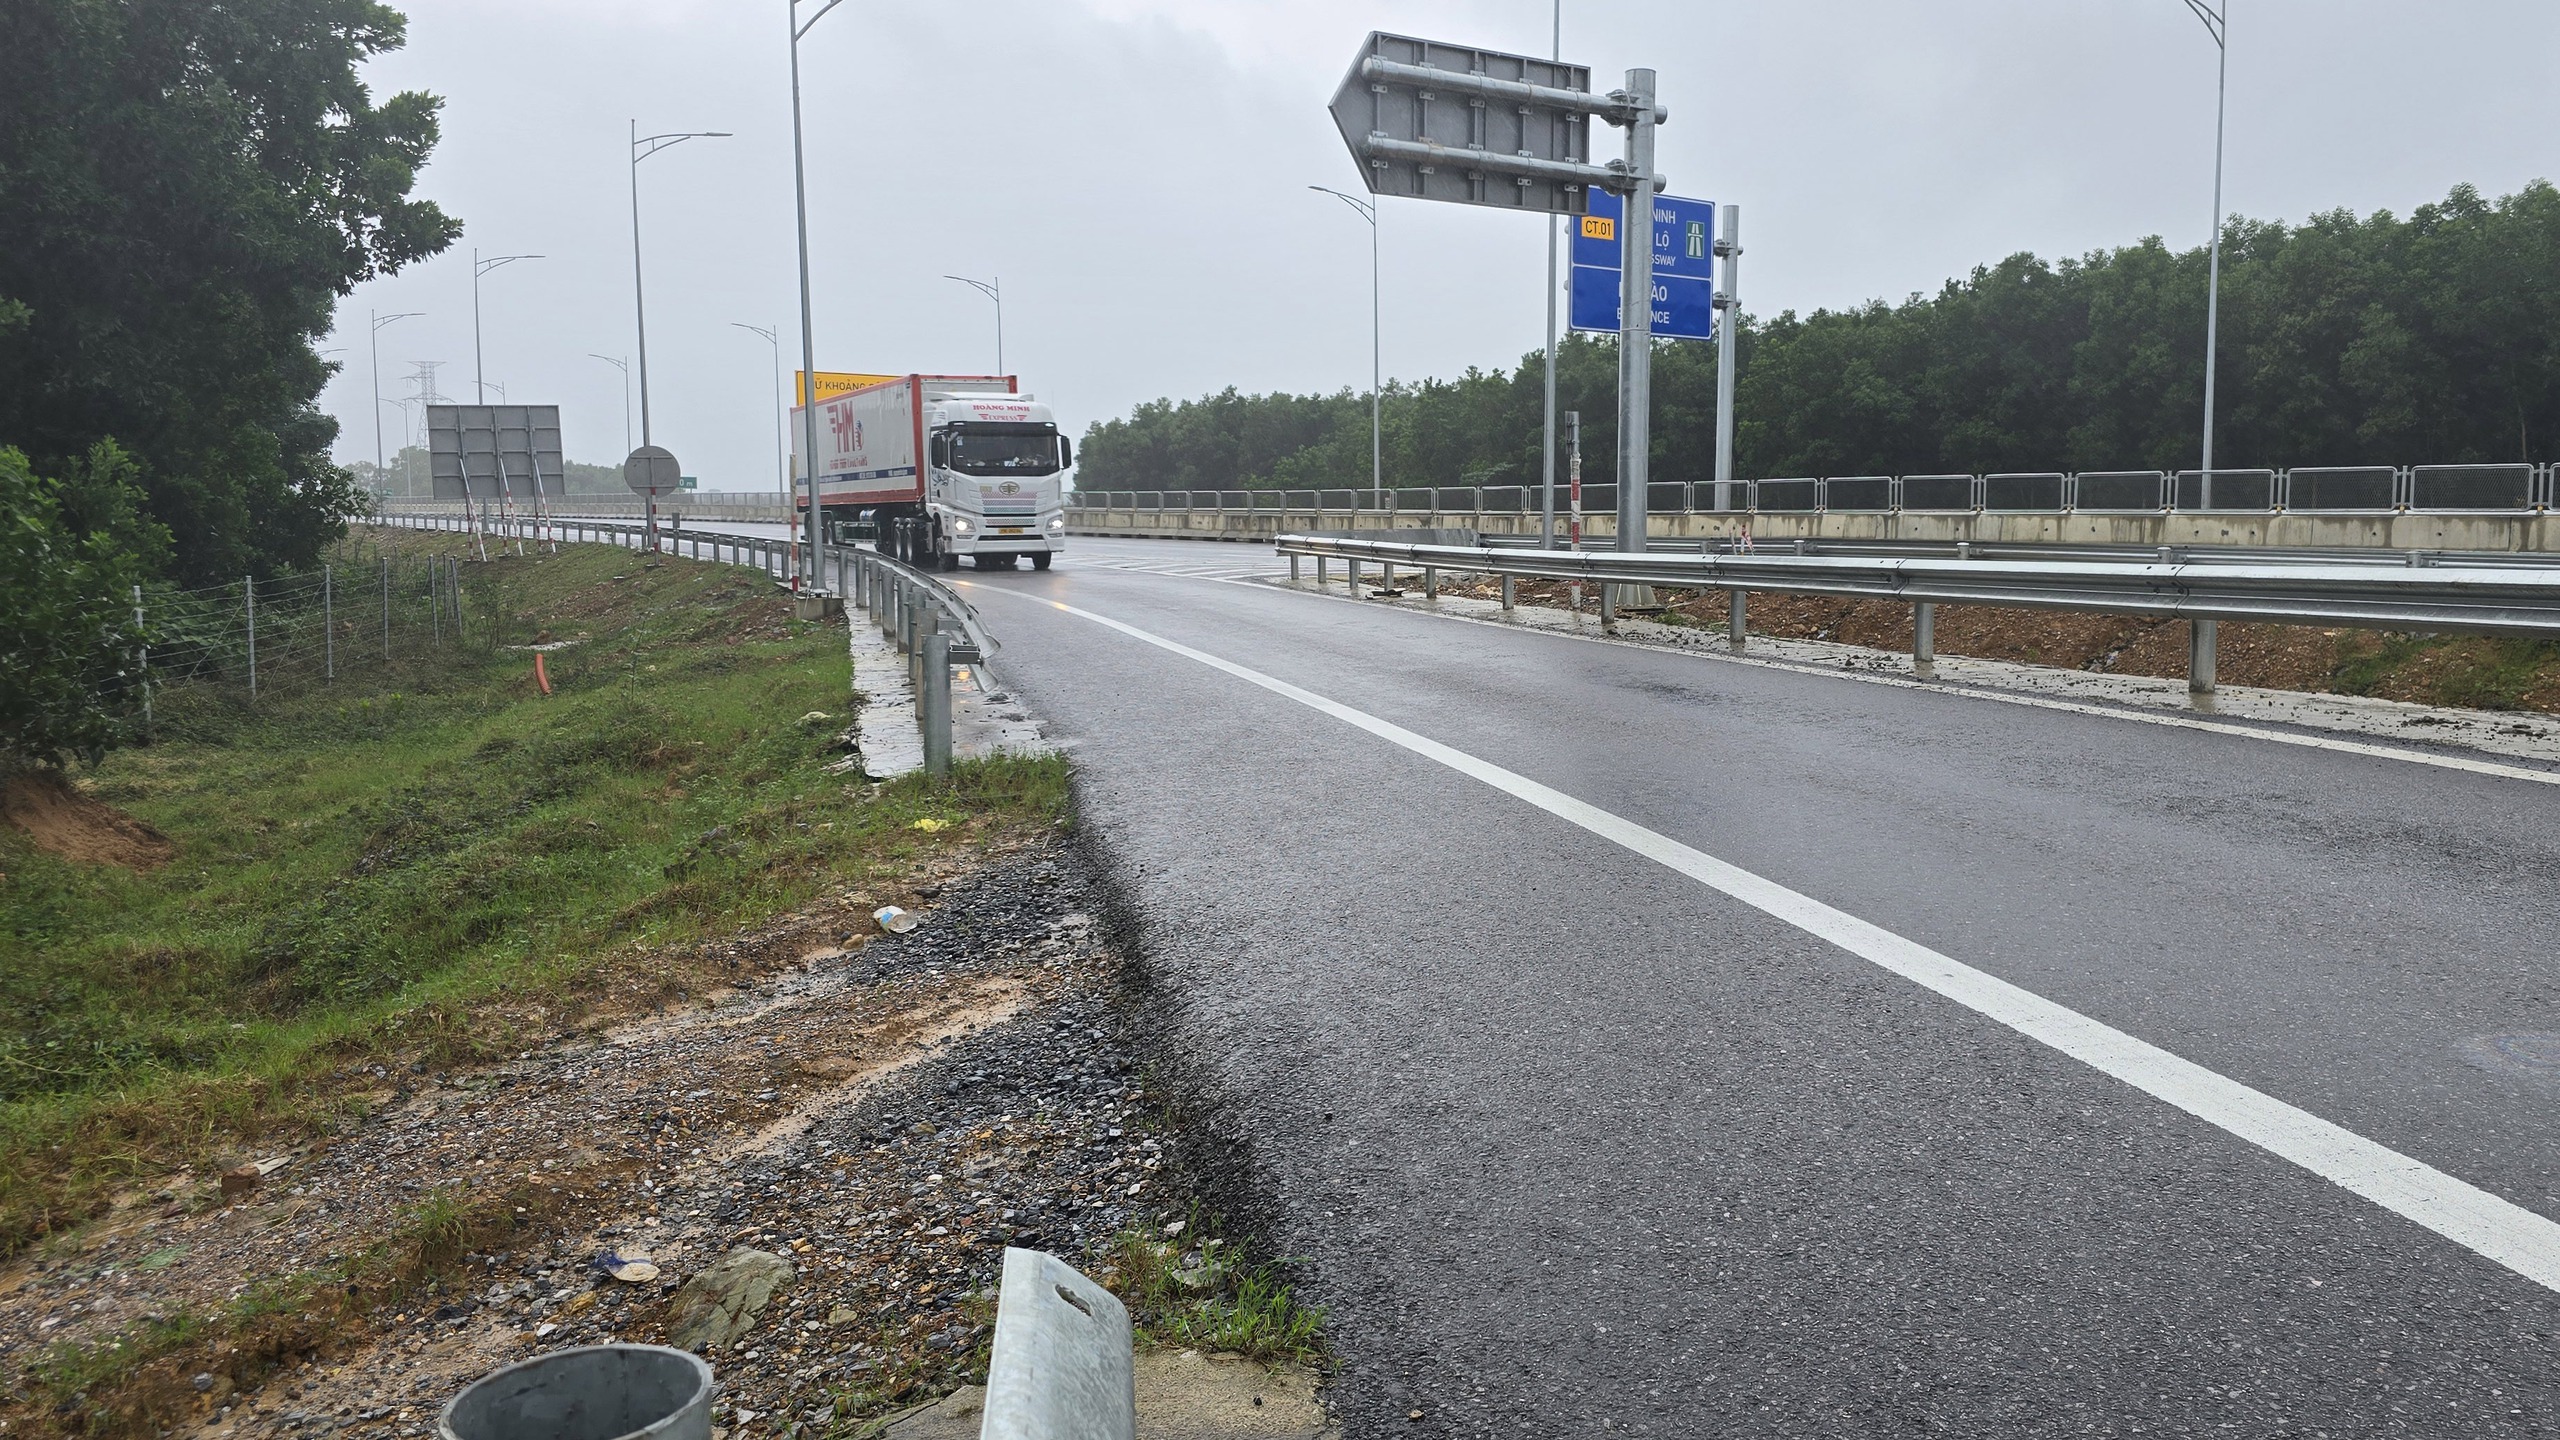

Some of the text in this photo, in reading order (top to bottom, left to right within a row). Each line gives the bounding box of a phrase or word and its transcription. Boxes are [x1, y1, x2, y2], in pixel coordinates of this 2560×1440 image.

[1585, 220, 1611, 236] CT.01
[1656, 230, 1669, 251] LỘ
[1651, 280, 1667, 302] ÀO
